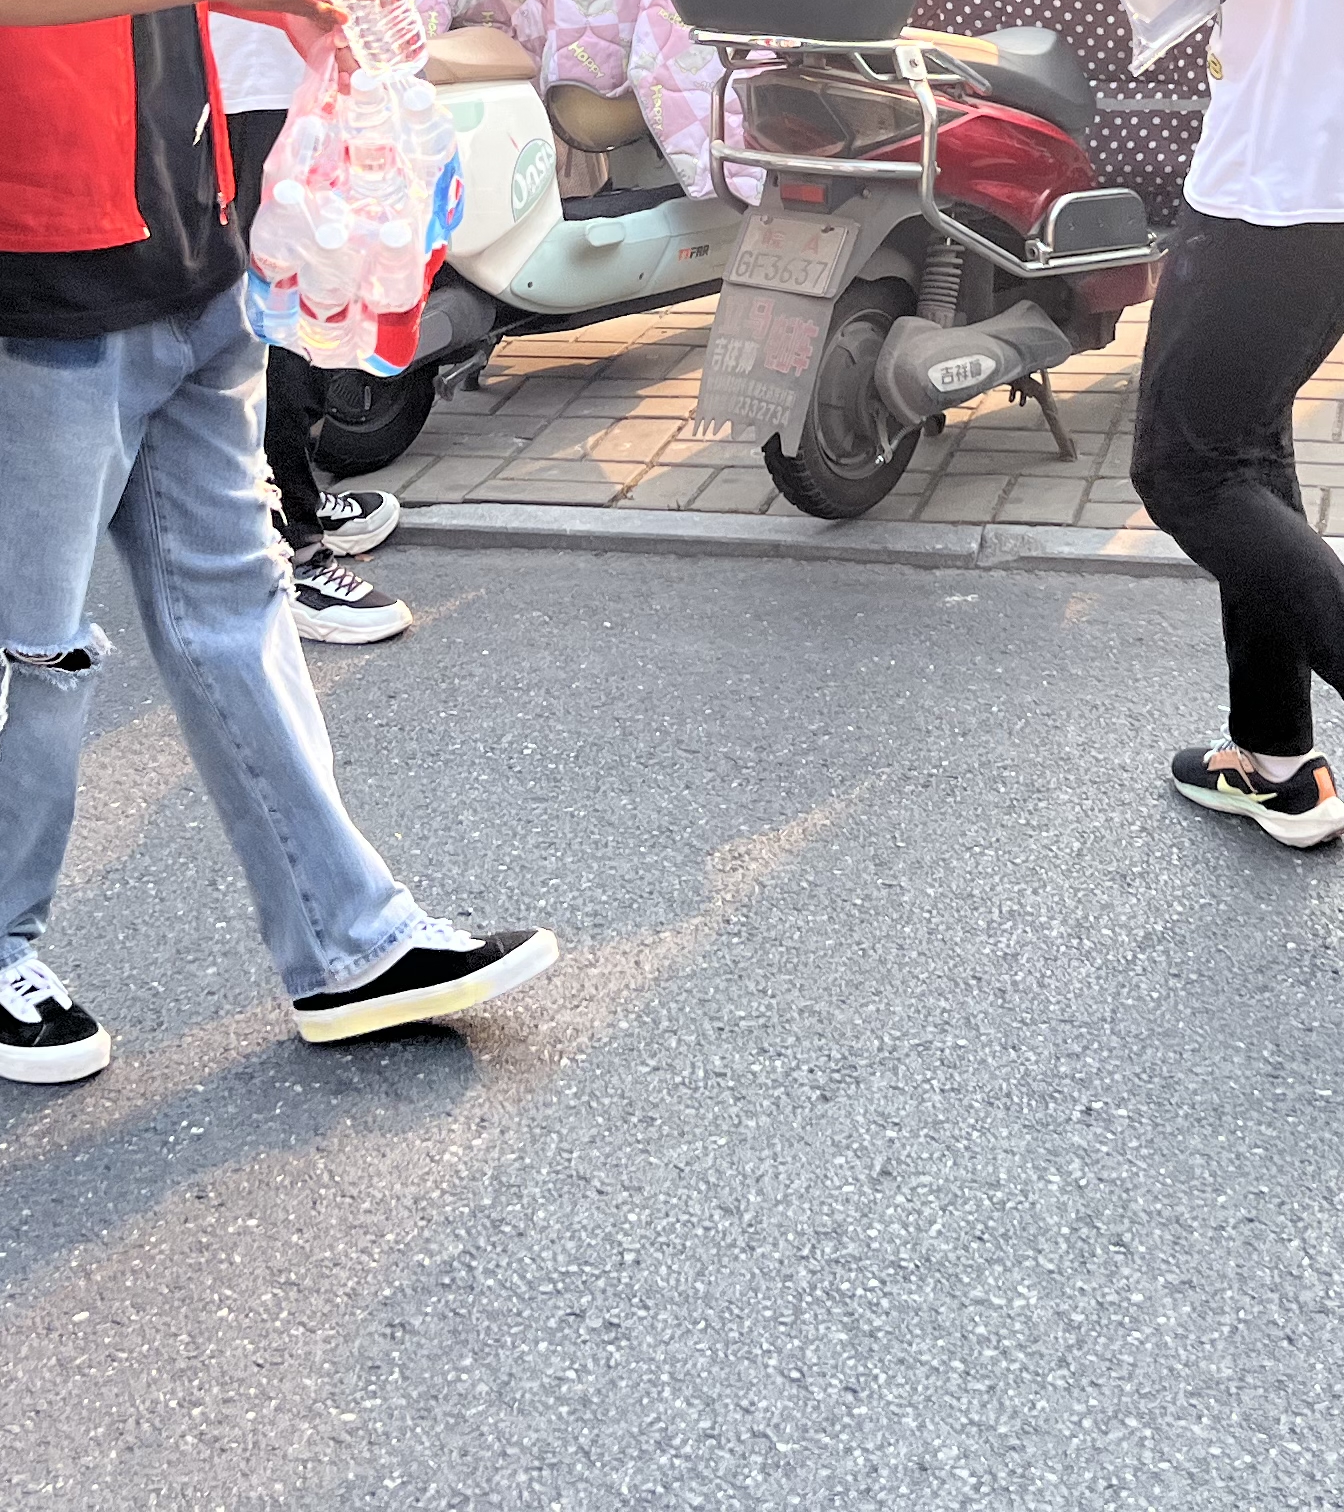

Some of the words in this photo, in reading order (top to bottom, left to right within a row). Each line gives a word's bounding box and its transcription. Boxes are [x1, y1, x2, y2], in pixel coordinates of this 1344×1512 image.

[567, 40, 605, 79] Happy
[650, 84, 663, 131] Happy
[801, 236, 820, 255] A
[735, 250, 829, 289] GF3637
